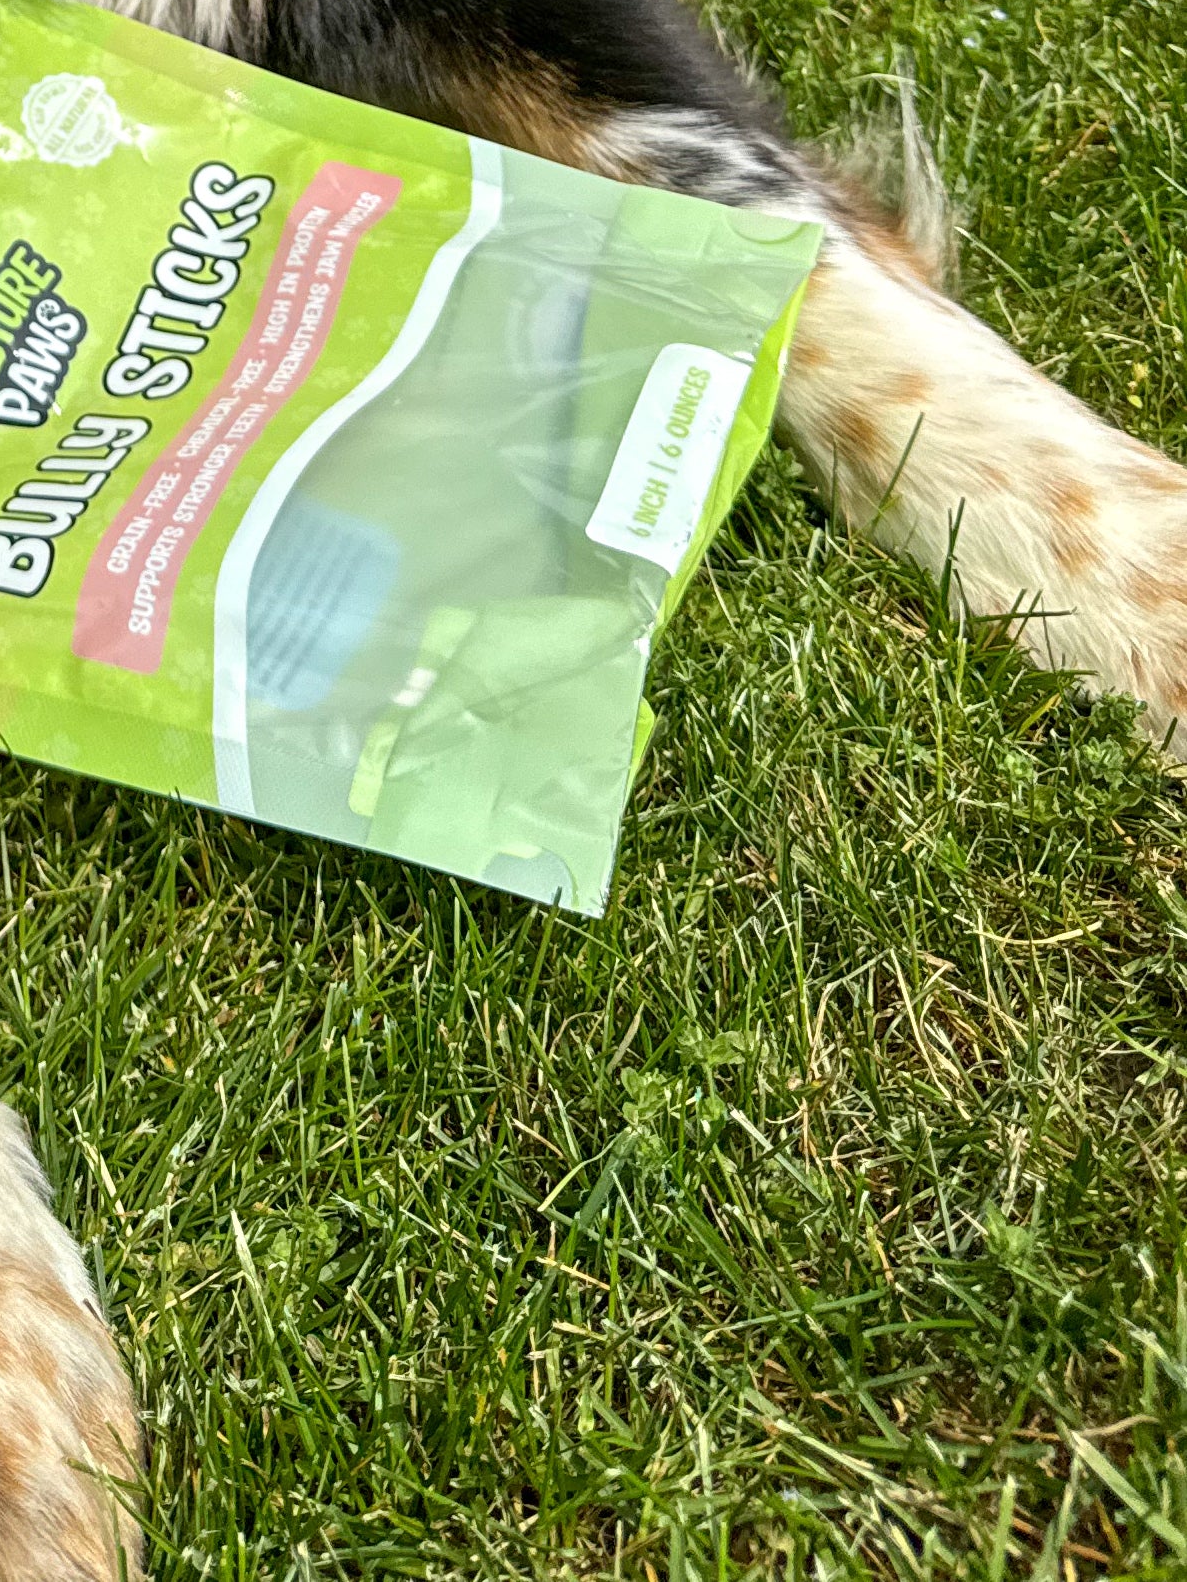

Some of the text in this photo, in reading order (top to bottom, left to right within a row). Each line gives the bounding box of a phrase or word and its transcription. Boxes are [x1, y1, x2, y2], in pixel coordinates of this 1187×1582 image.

[103, 161, 275, 399] STICKS
[107, 471, 182, 574] GRAIN-FREE
[177, 358, 268, 459] CHEMICAL-FREE
[261, 299, 292, 345] HIGH
[277, 272, 300, 296] IN
[128, 525, 185, 636] SUPPORTS
[173, 443, 237, 523] STRONGER
[225, 403, 268, 441] TEETH
[264, 283, 331, 393] STRENGTHENS
[315, 232, 343, 278] JAW
[666, 366, 711, 439] OUNCES
[658, 443, 683, 458] 6
[625, 525, 651, 539] 6
[632, 477, 669, 526] INCH
